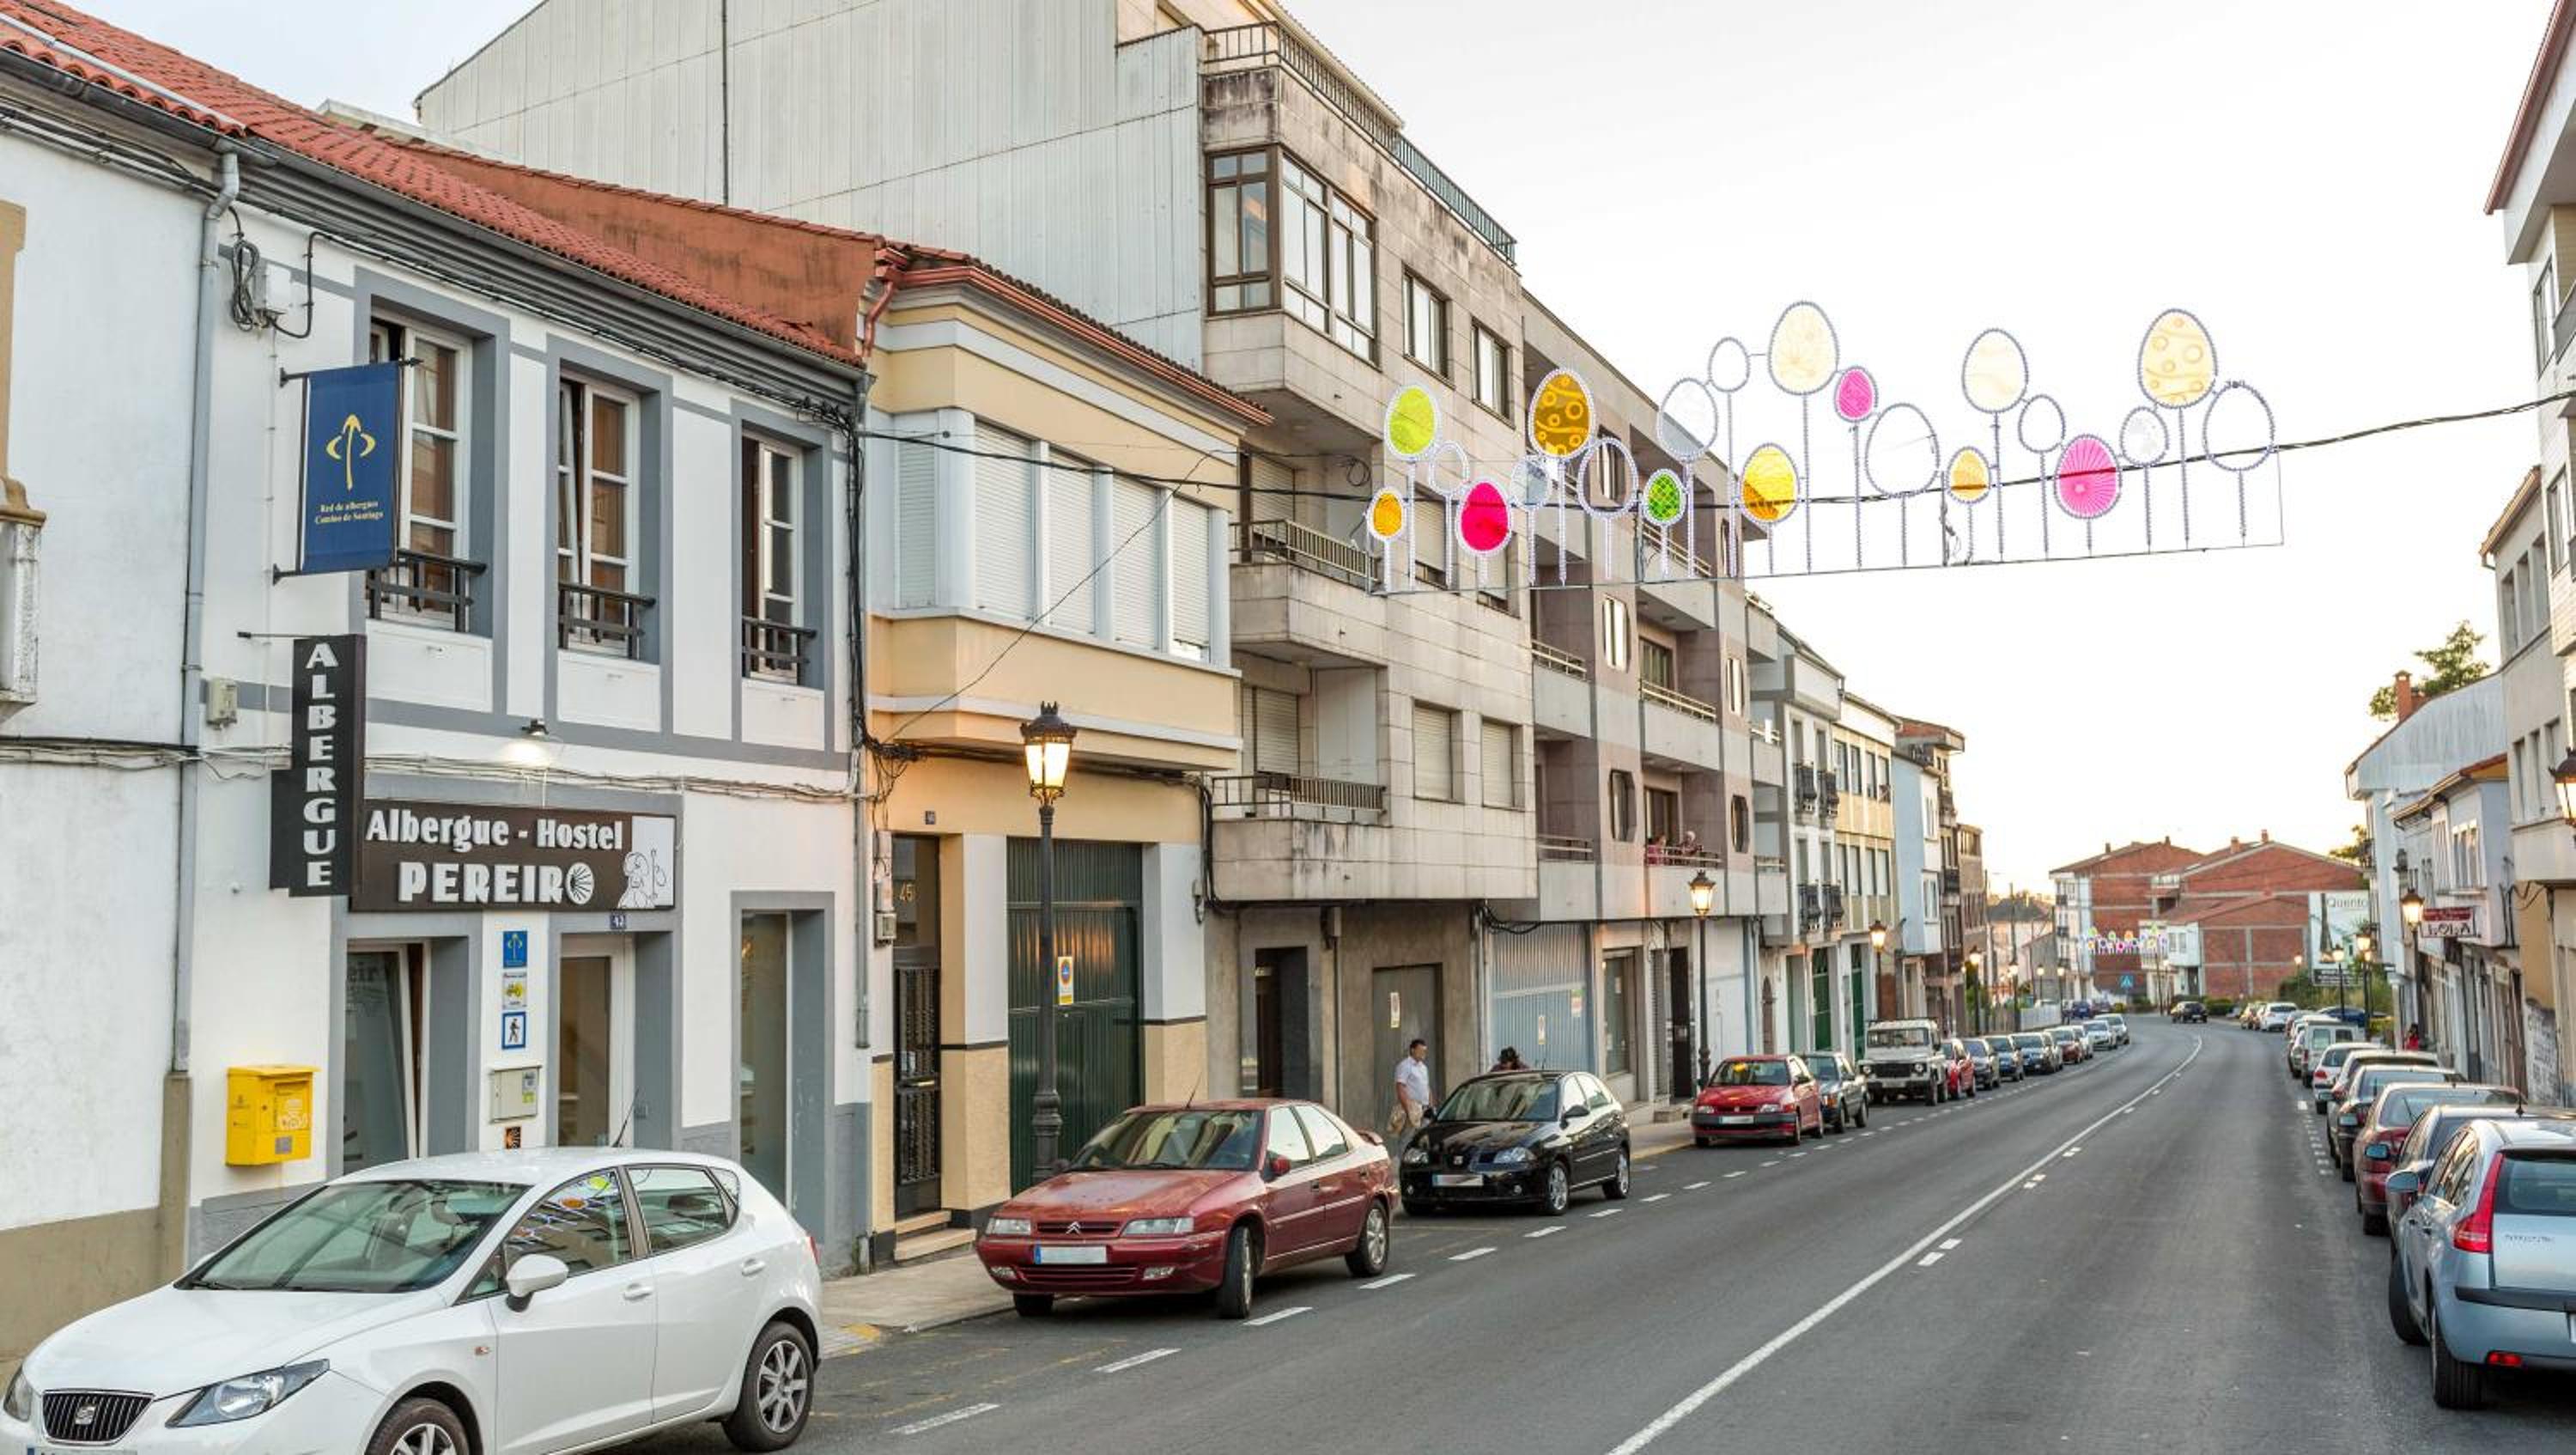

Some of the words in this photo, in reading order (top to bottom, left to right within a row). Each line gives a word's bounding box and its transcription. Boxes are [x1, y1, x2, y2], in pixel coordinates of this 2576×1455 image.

[304, 642, 339, 887] ALBERGUE
[365, 808, 509, 853] Albergue
[536, 818, 623, 849] Hostel
